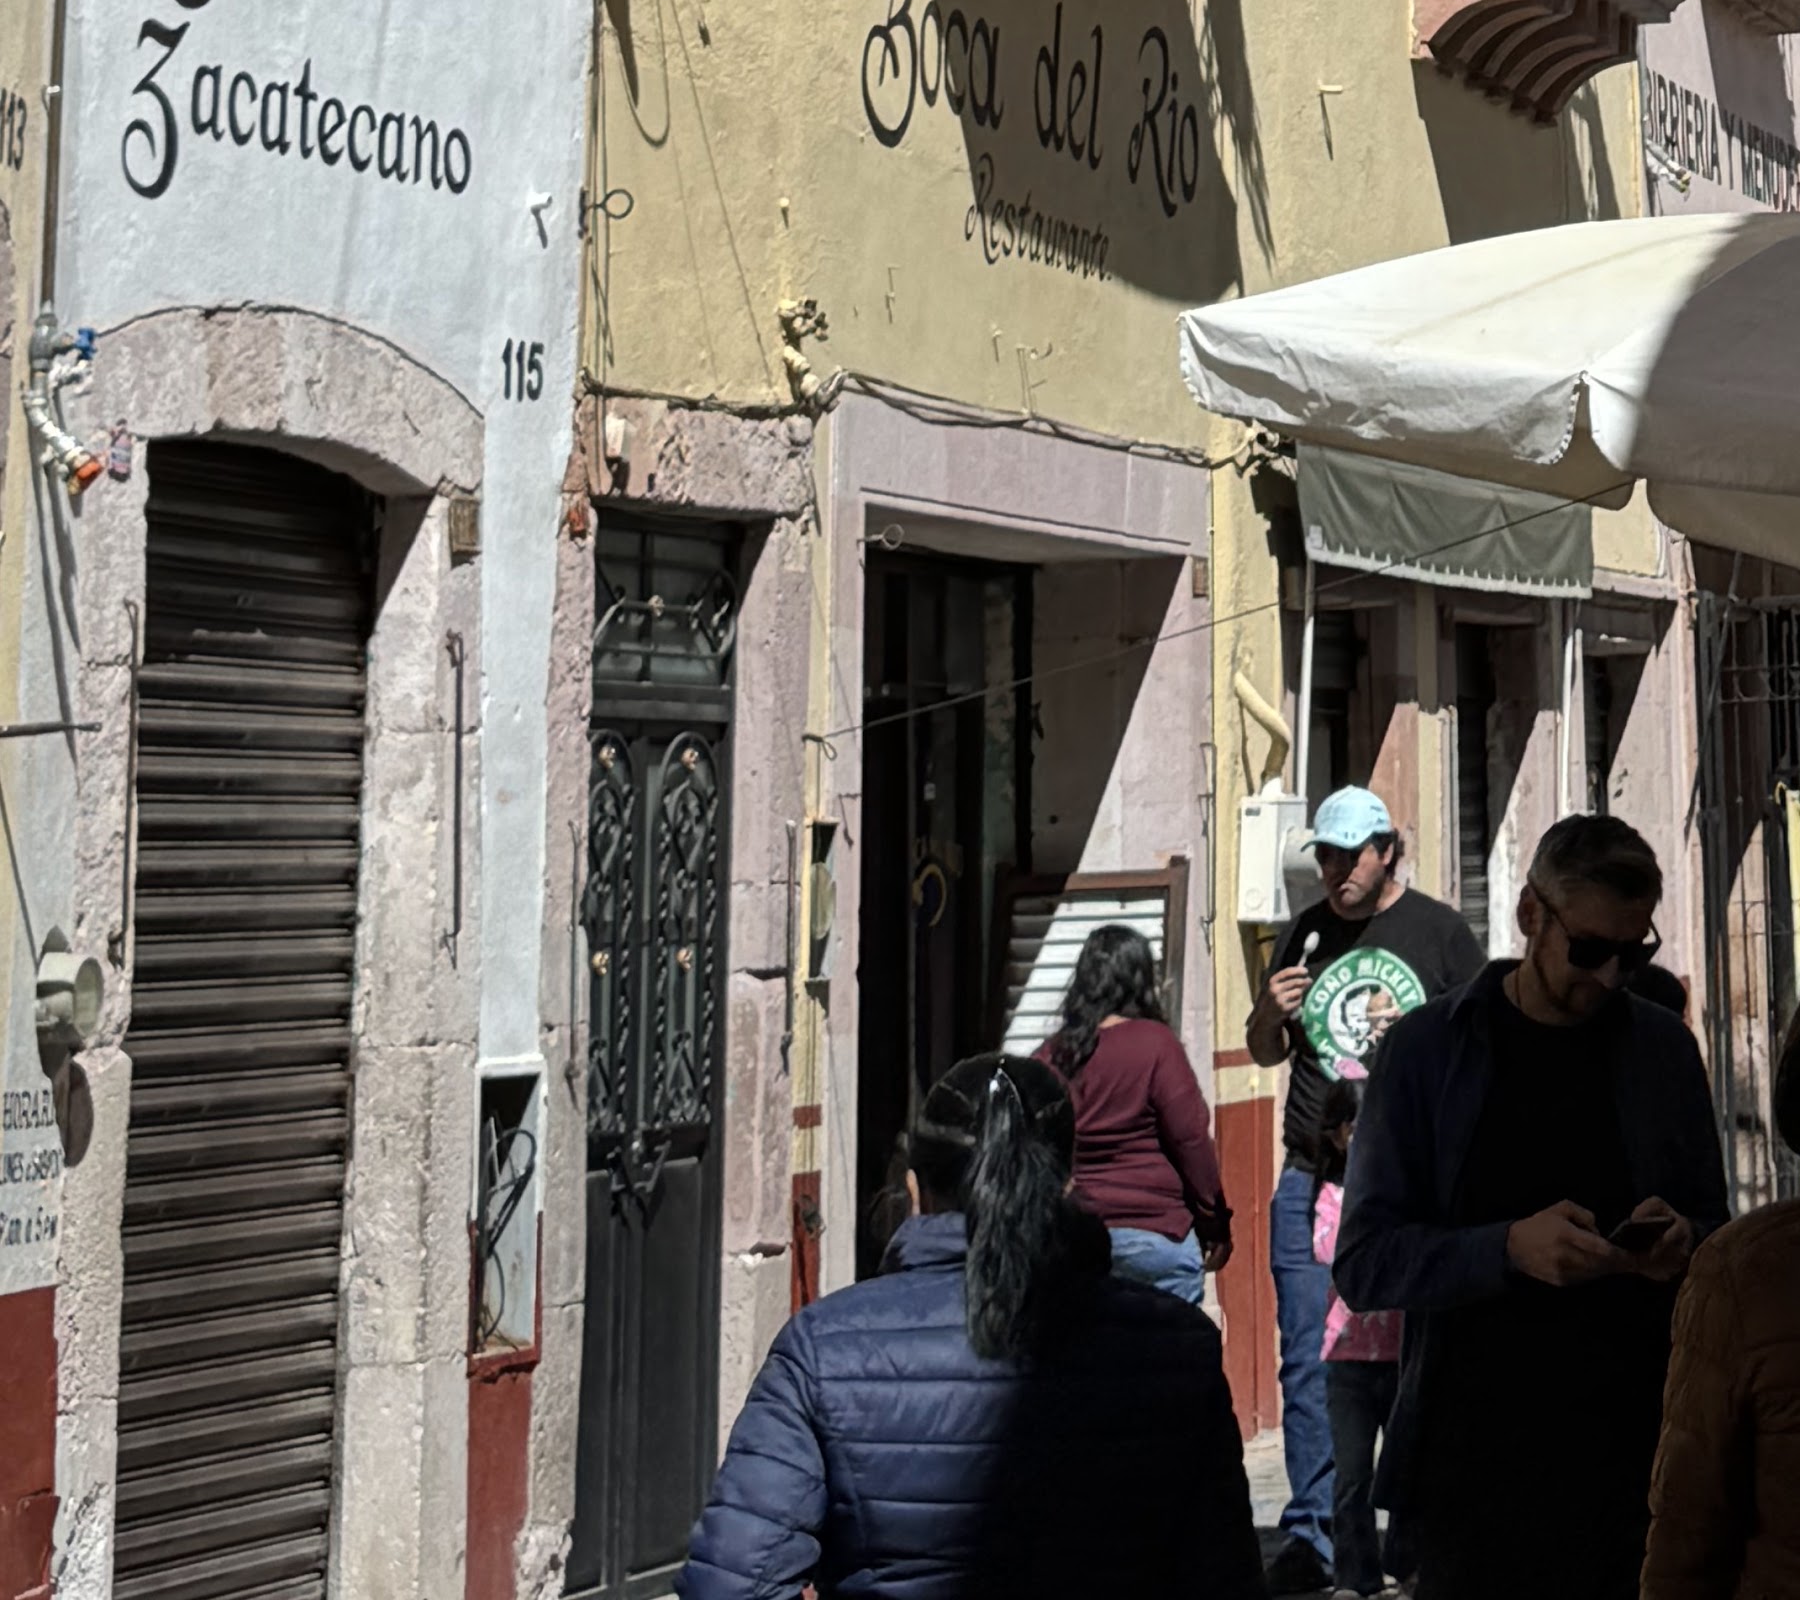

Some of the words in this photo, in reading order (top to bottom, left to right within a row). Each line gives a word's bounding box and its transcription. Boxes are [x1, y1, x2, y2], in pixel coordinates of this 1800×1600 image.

[122, 19, 470, 198] Zacatecano
[1034, 2, 1103, 169] del
[1724, 109, 1737, 191] Y
[501, 338, 544, 402] 115
